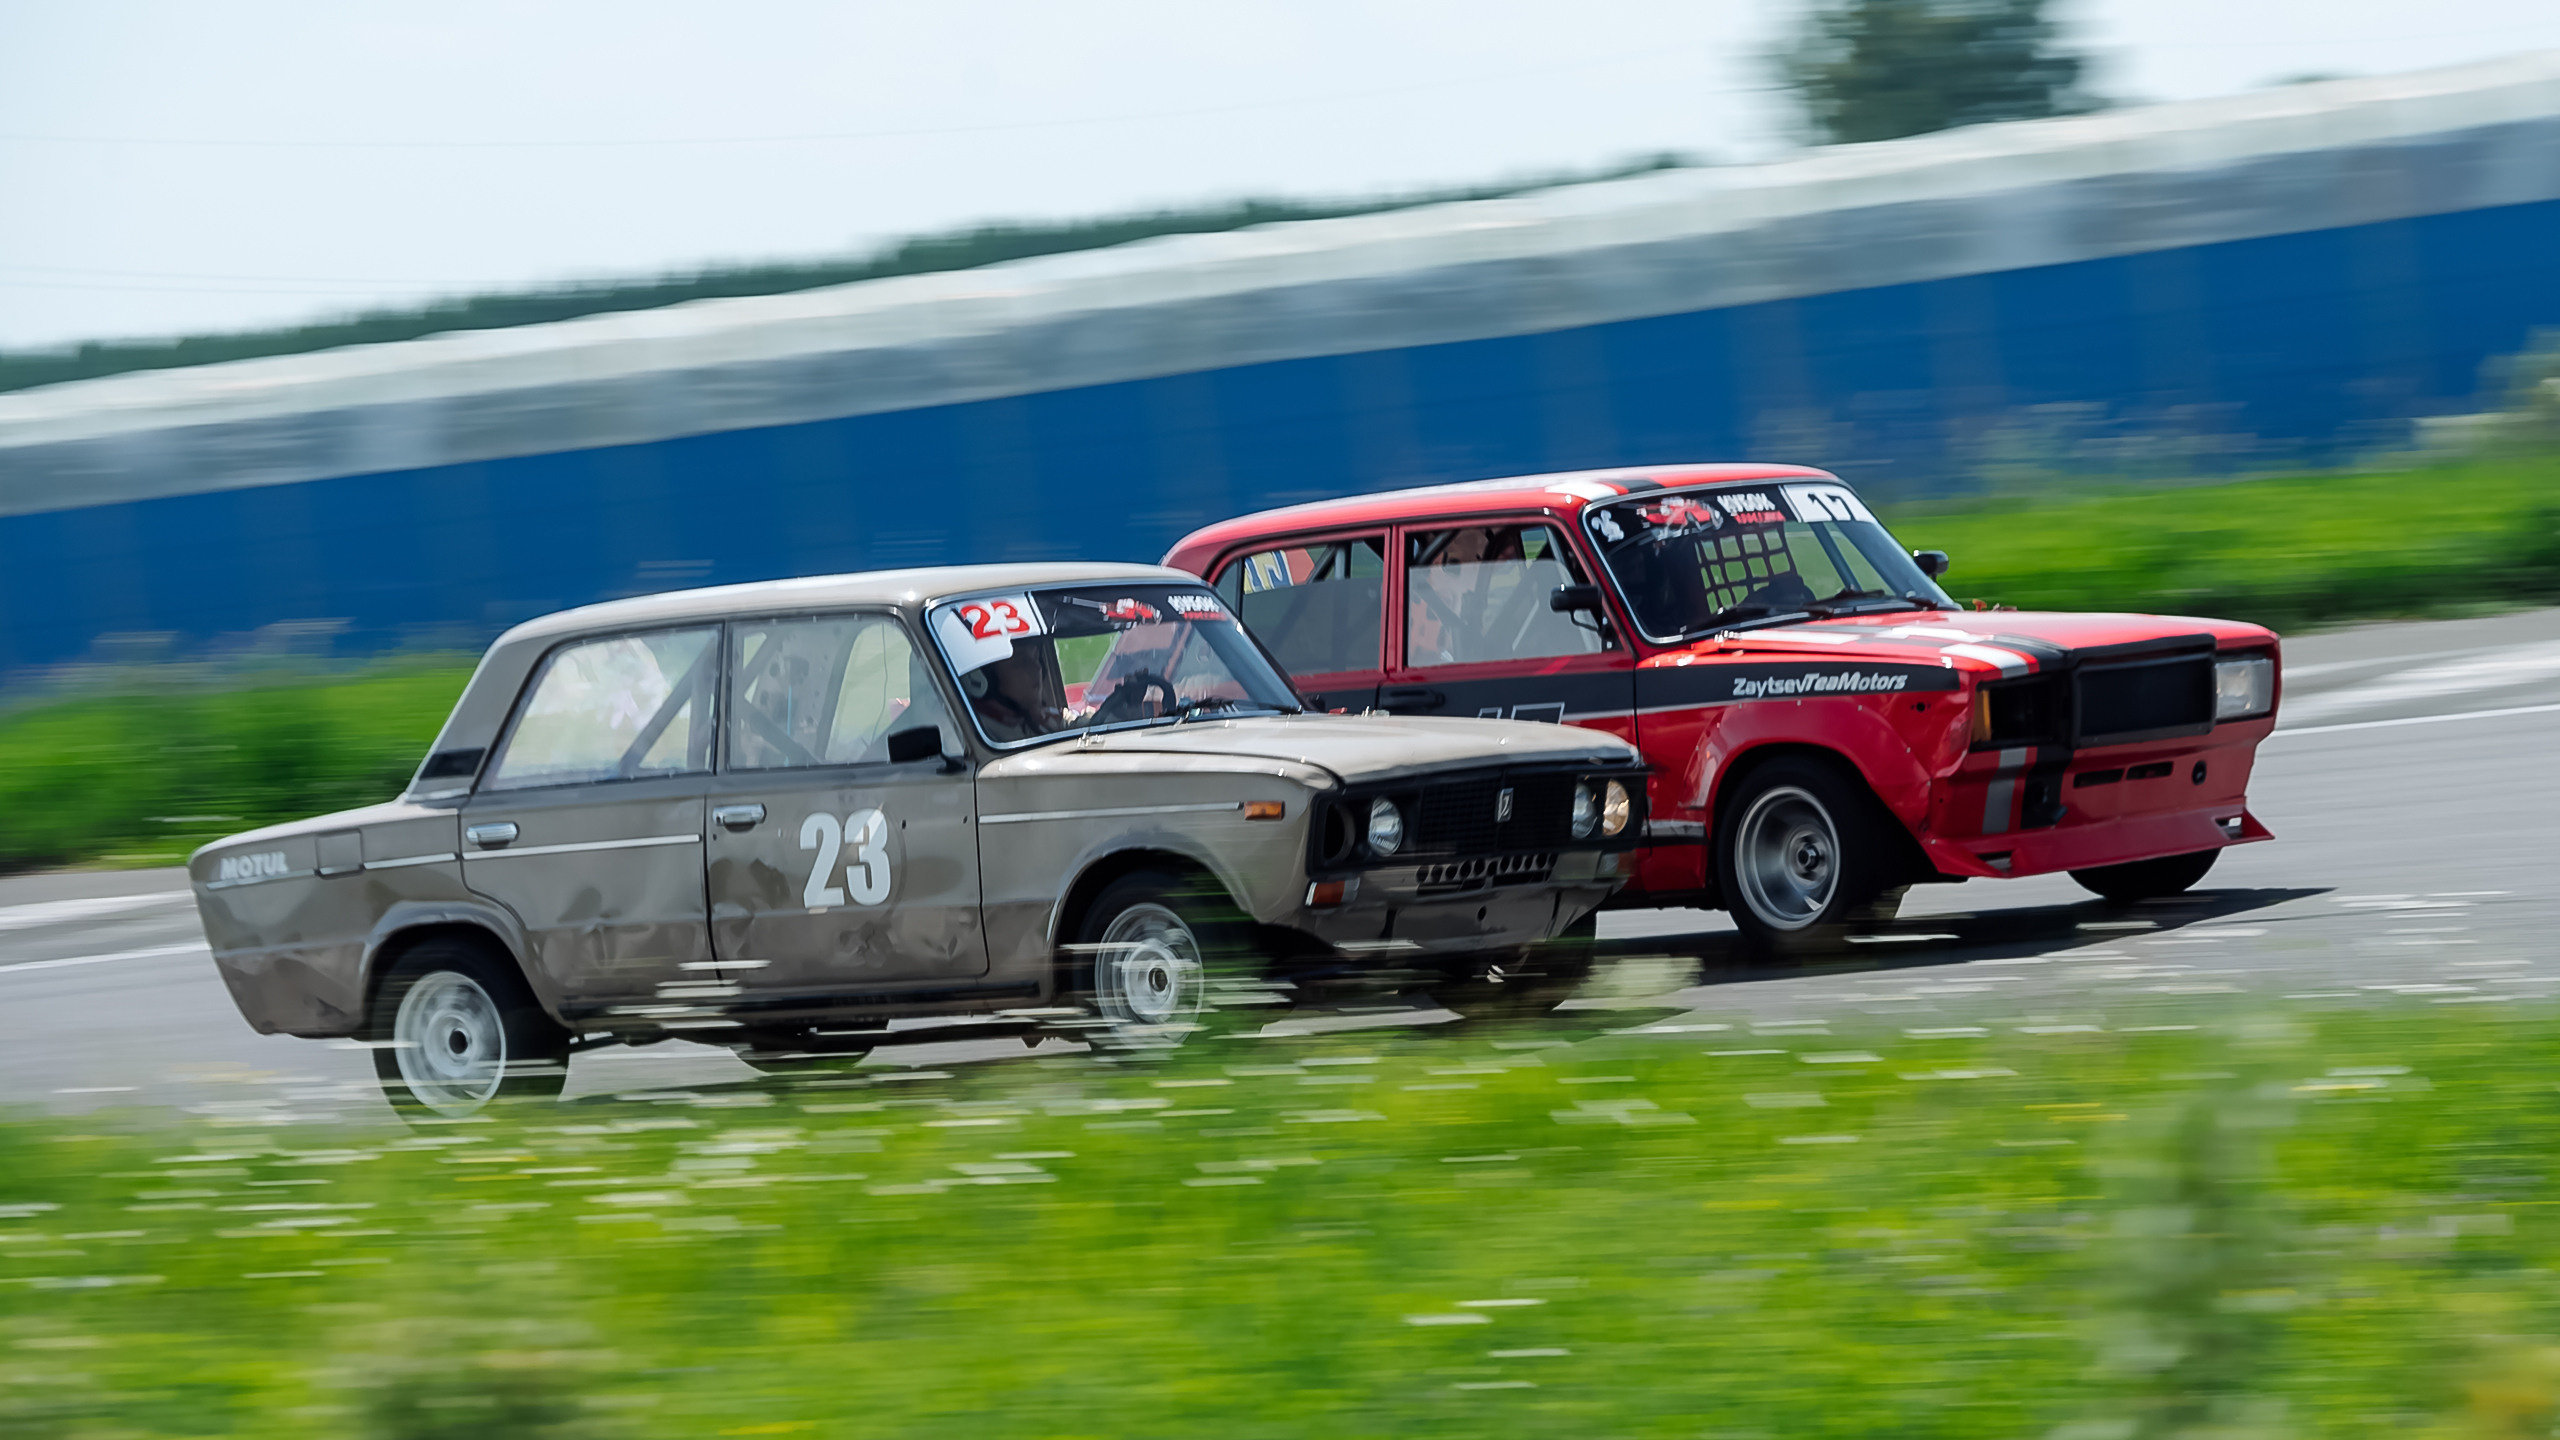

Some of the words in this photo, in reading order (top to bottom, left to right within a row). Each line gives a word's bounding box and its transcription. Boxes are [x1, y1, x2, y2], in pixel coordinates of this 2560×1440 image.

[960, 600, 1030, 638] 23
[220, 851, 288, 880] MOTUL
[800, 808, 891, 908] 23
